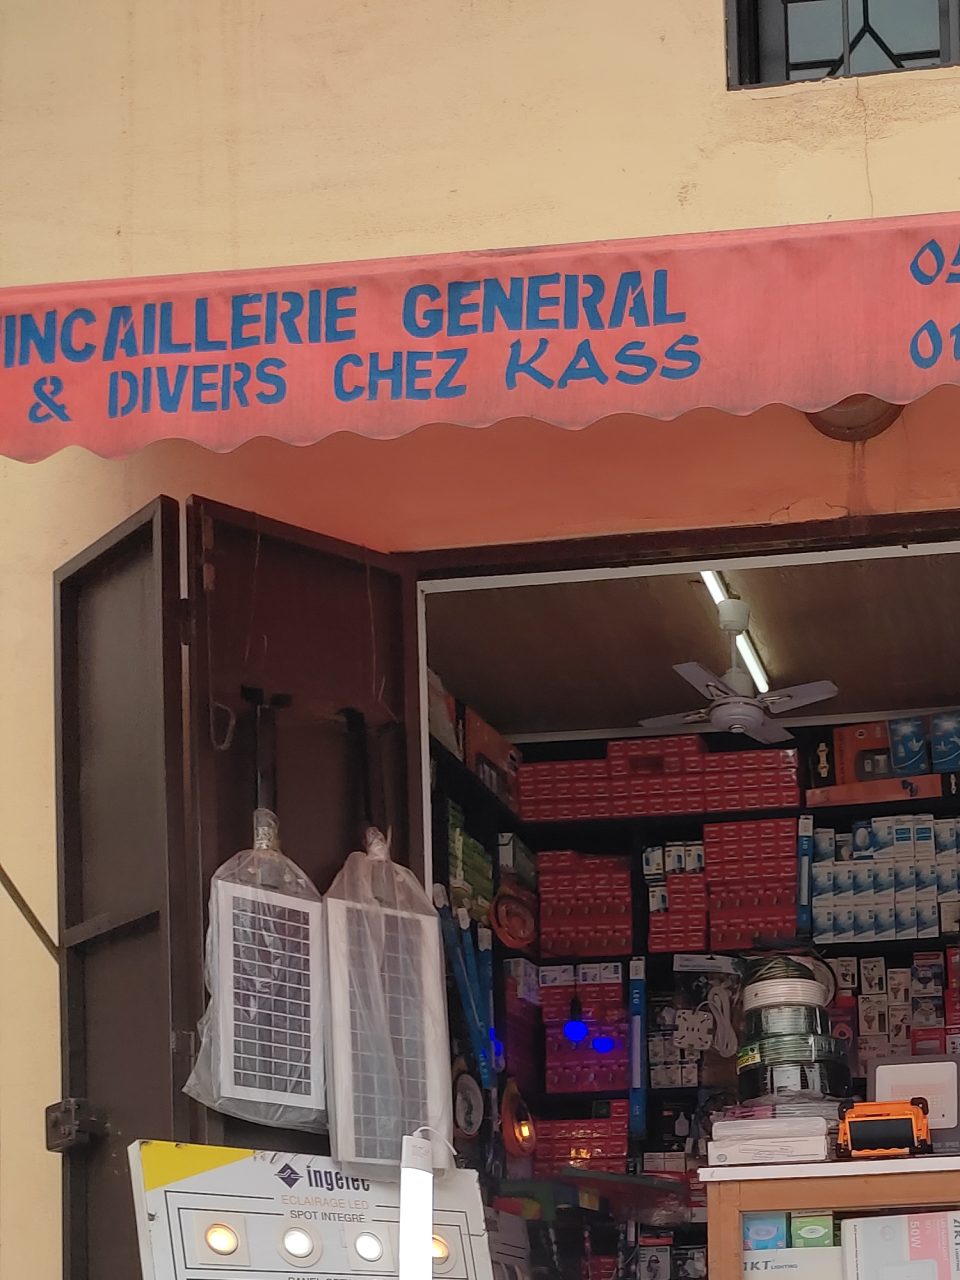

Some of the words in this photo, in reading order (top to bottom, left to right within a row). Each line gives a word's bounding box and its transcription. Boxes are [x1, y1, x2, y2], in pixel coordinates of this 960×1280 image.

[0, 286, 357, 369] INCAILLERIE
[402, 269, 686, 338] GENERAL
[28, 375, 71, 424] &
[108, 358, 286, 418] DIVERS
[333, 348, 469, 402] CHEZ
[505, 335, 702, 390] KASS
[290, 1209, 318, 1220] SPOT
[349, 1200, 369, 1210] LED
